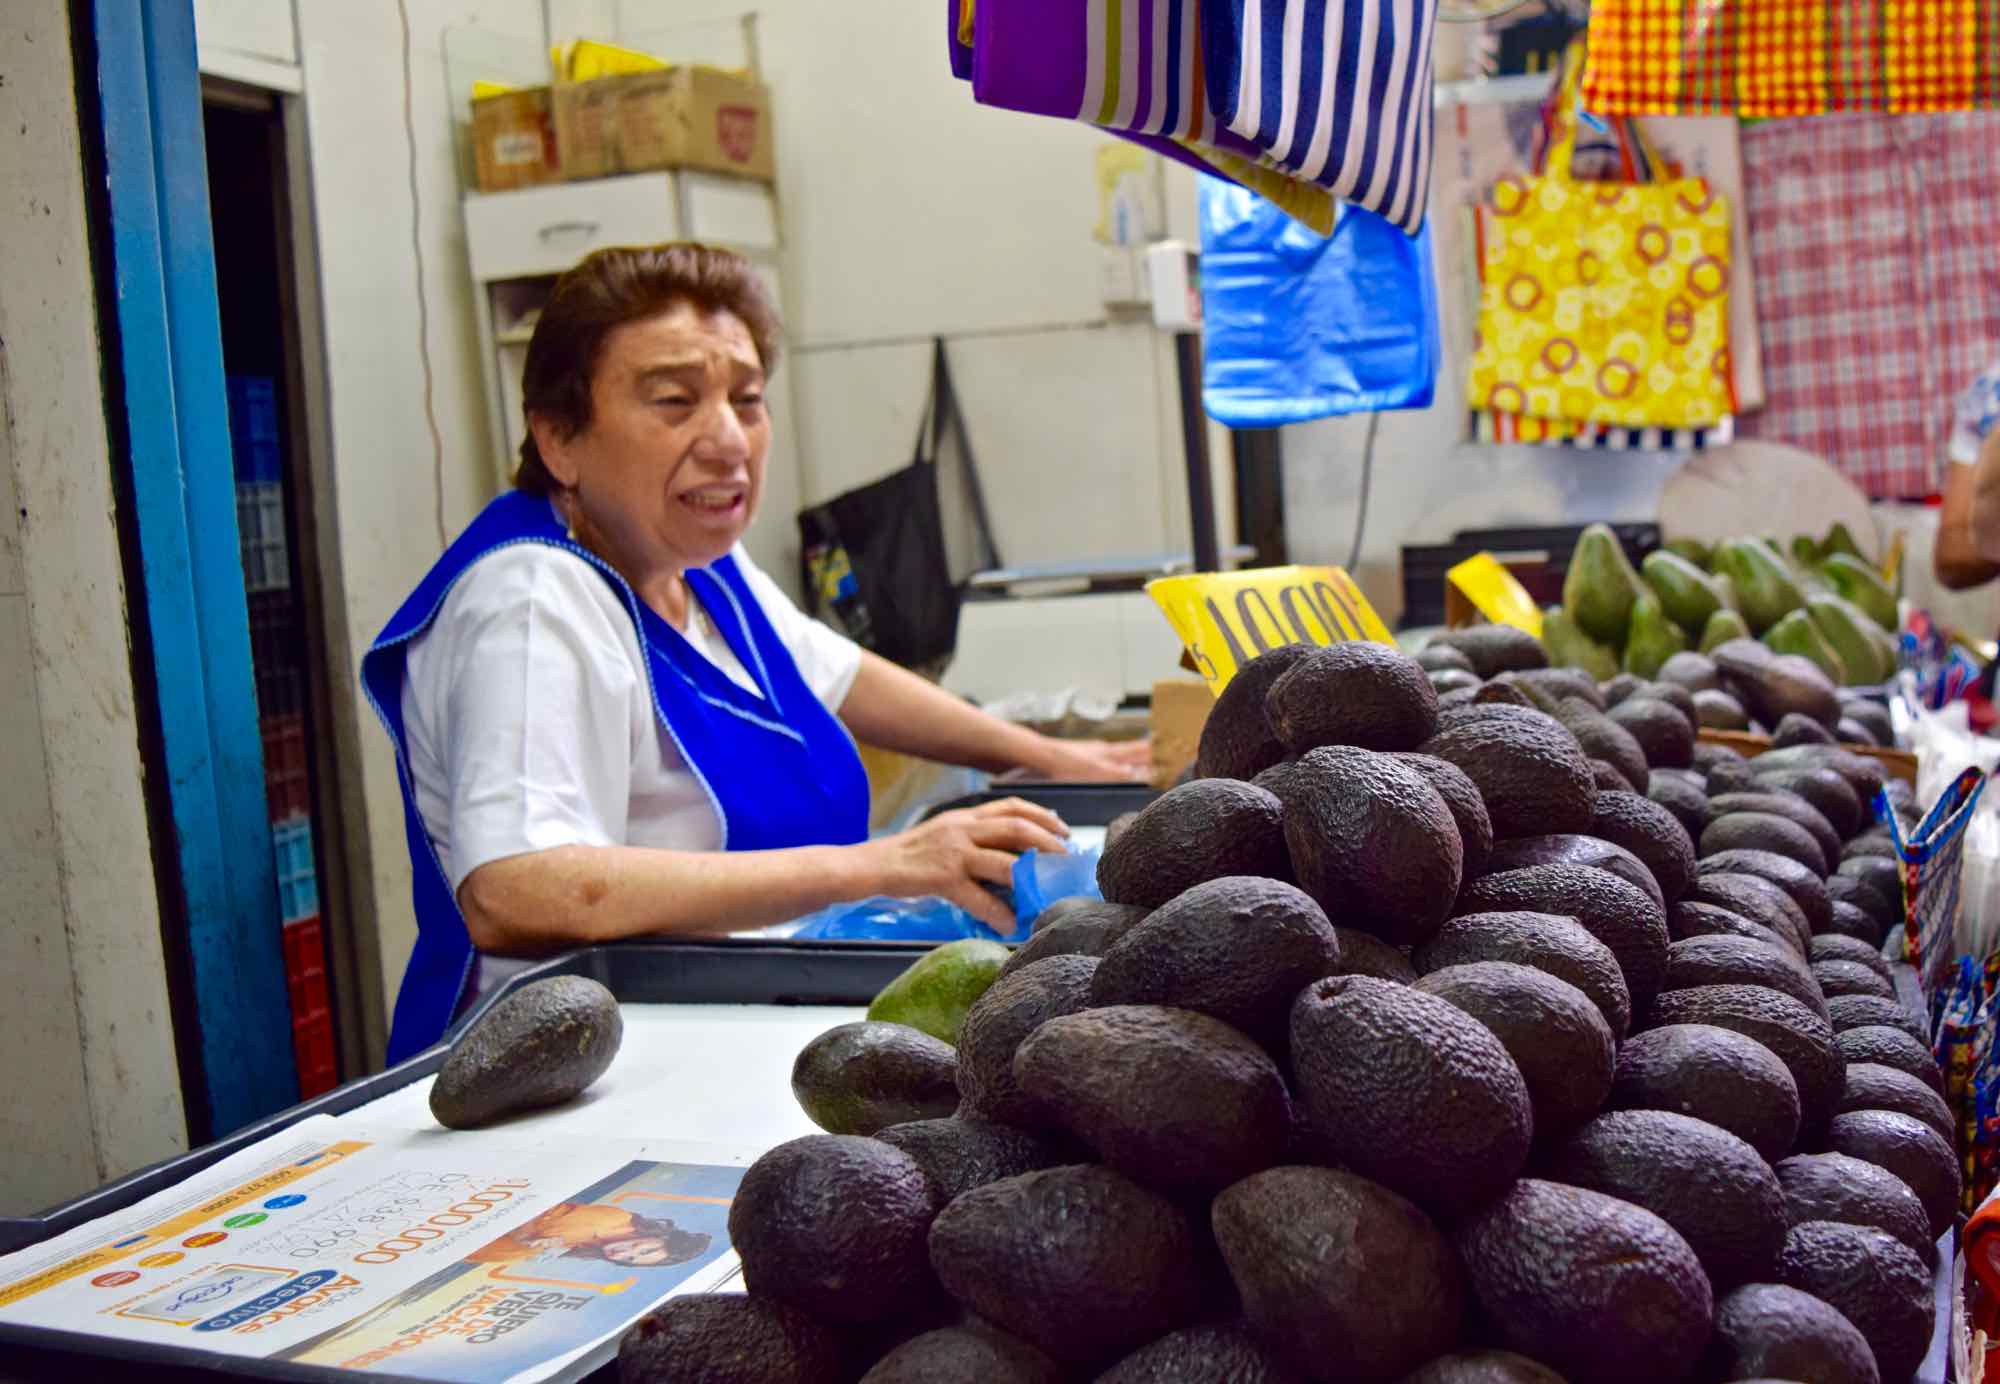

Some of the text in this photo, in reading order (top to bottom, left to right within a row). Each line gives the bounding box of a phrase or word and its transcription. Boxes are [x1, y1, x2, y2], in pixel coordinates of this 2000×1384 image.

[416, 1171, 471, 1193] DE
[210, 1274, 324, 1331] efectivo
[234, 1274, 361, 1335] Avance
[447, 1290, 544, 1340] VER DE
[465, 1291, 564, 1345] QUIERO
[553, 1294, 596, 1312] TE
